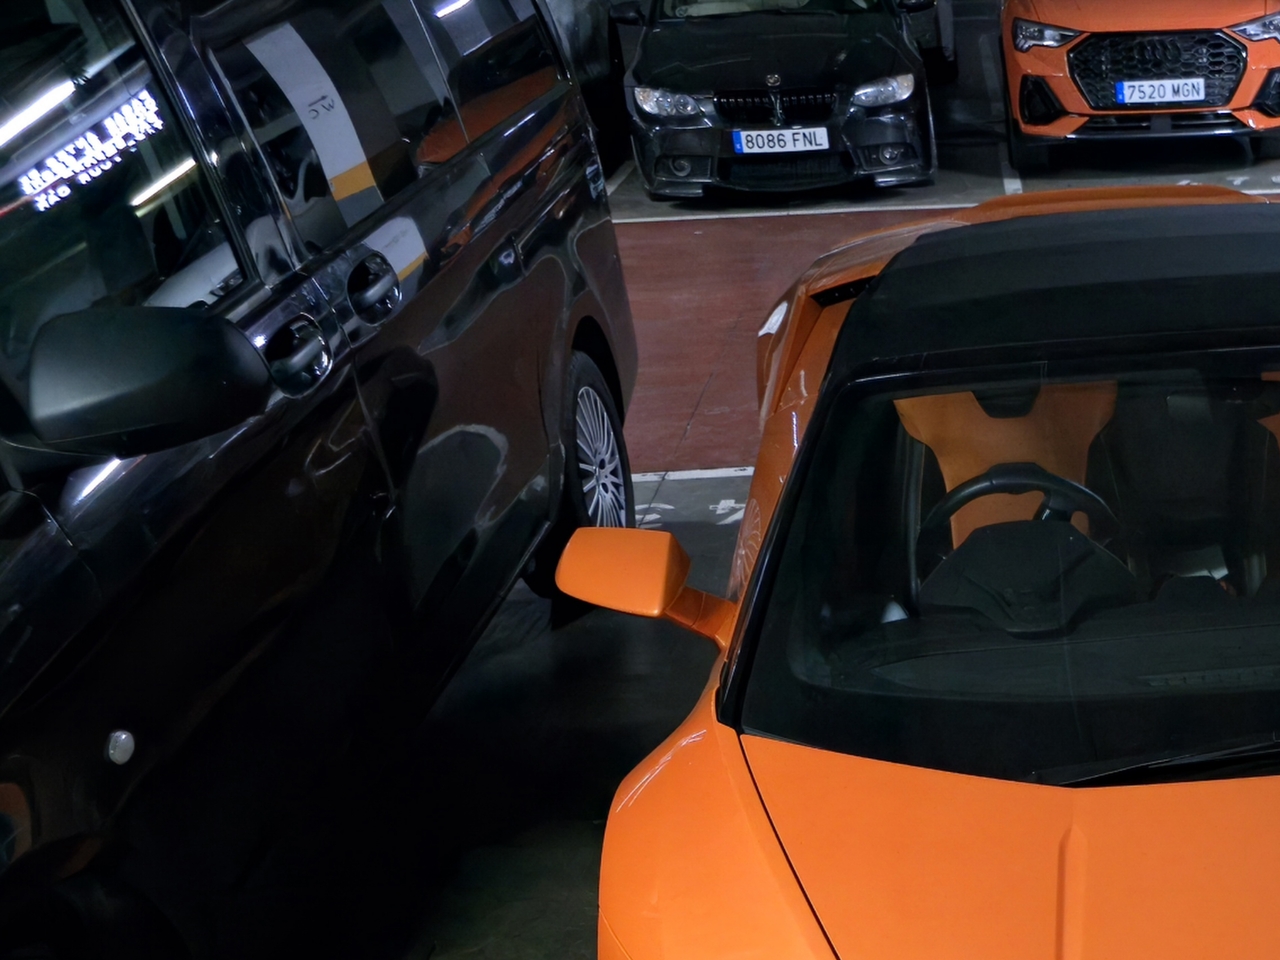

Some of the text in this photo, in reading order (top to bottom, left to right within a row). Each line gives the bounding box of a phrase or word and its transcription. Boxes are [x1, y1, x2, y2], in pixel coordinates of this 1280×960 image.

[1127, 82, 1201, 100] 7520 MGN
[745, 133, 787, 150] 8086
[792, 131, 823, 148] FNL
